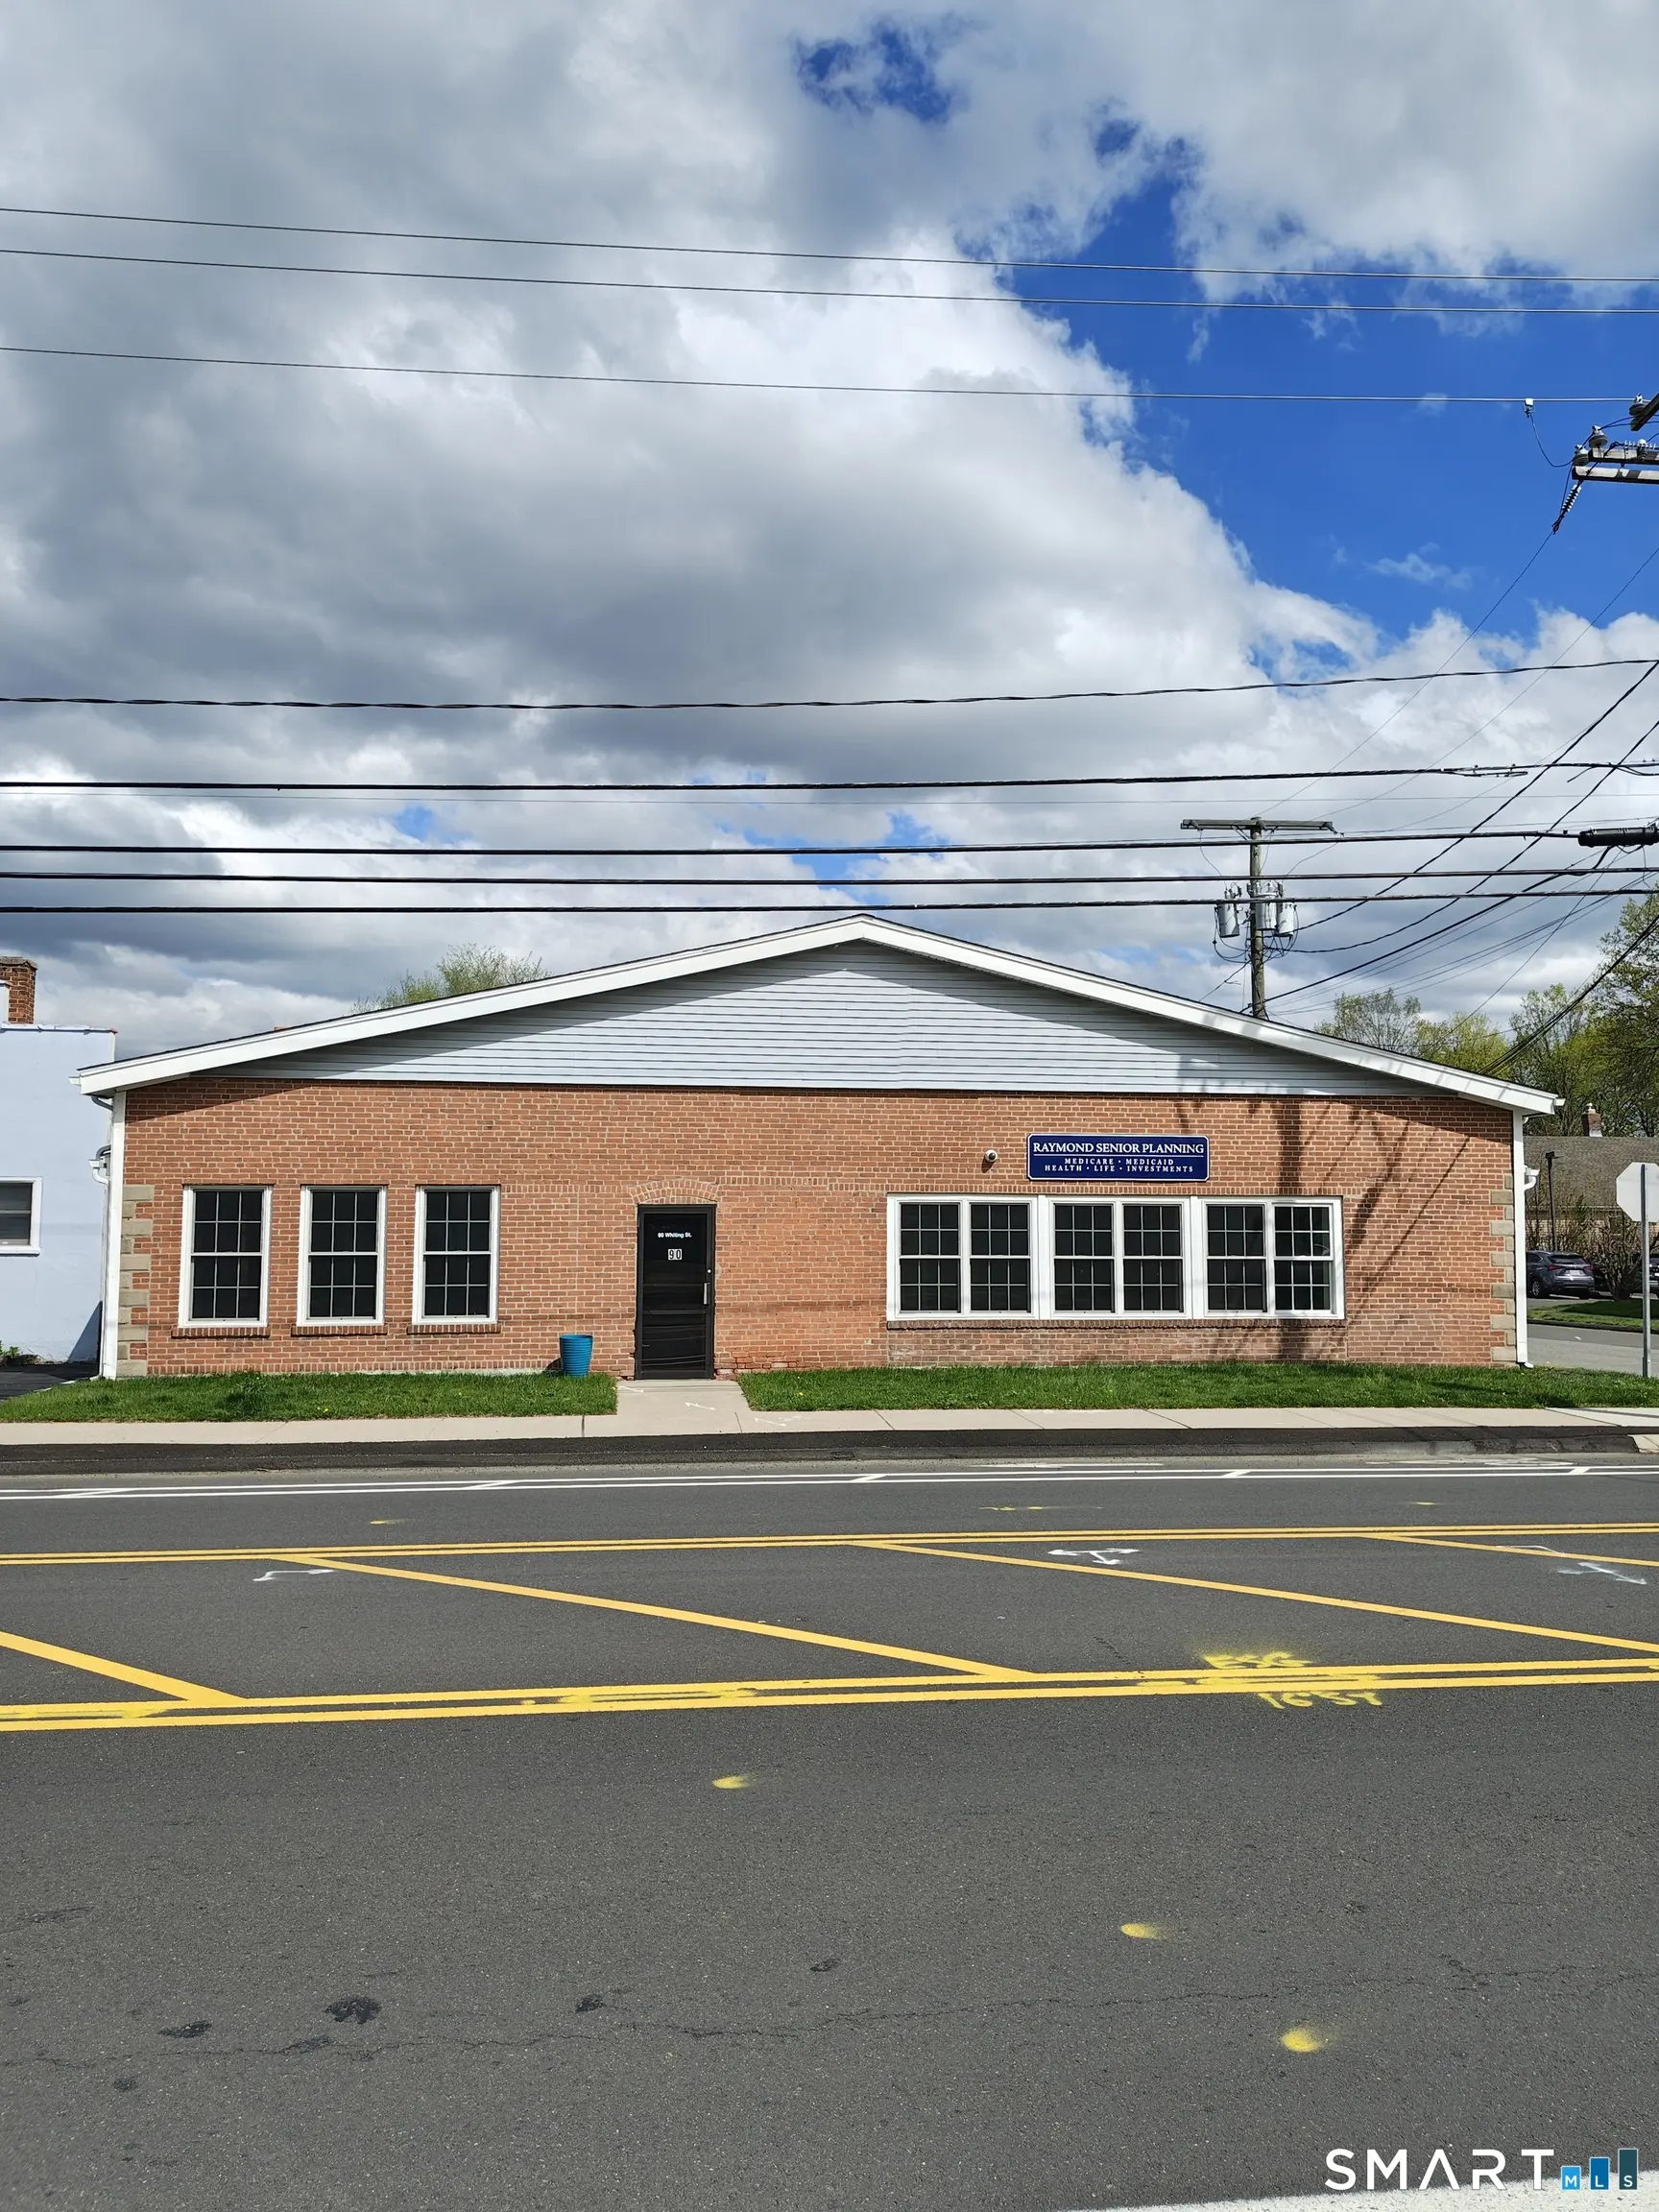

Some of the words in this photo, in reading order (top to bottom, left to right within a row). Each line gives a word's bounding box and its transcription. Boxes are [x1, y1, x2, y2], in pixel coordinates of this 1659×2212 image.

[1033, 1142, 1094, 1153] RAYMOND
[1095, 1142, 1141, 1154] SENIOR
[1142, 1143, 1205, 1154] PLANNING
[668, 1249, 682, 1260] 90
